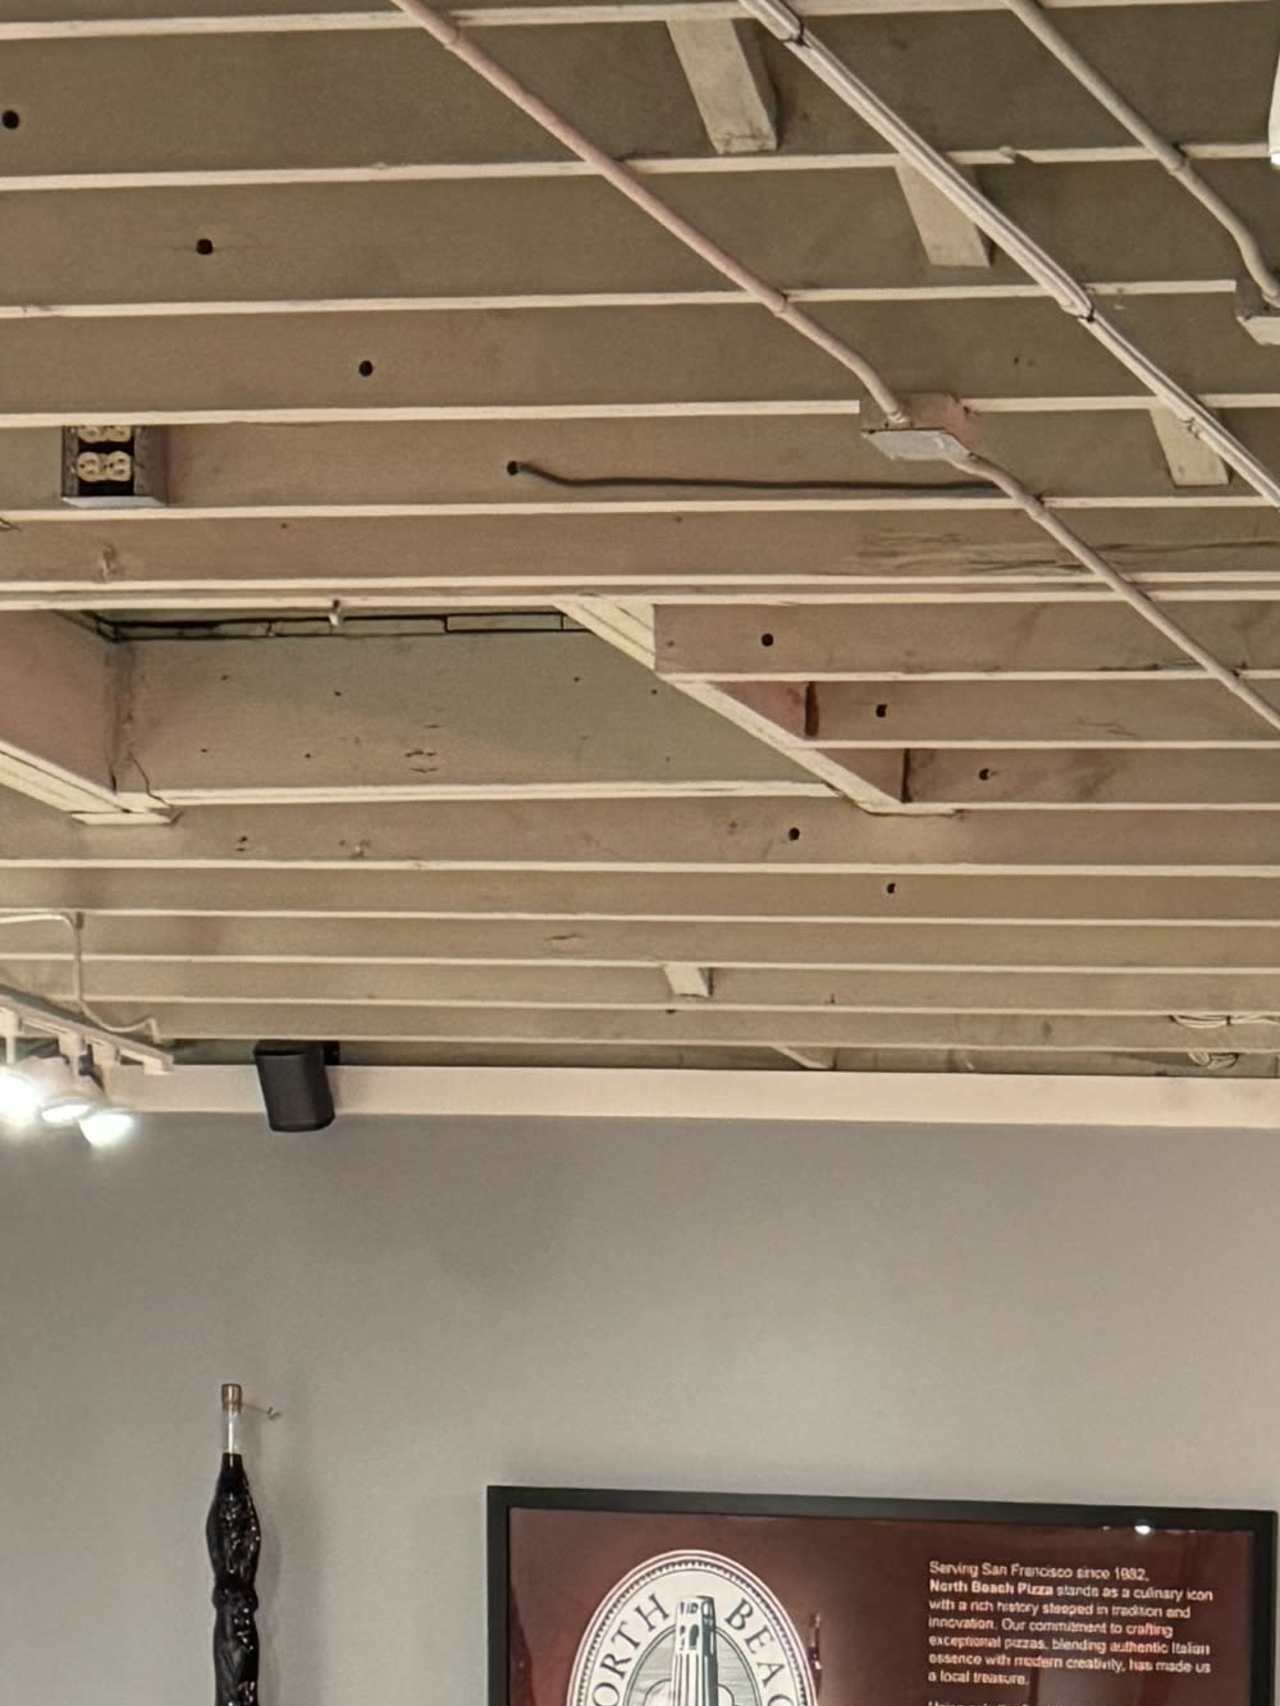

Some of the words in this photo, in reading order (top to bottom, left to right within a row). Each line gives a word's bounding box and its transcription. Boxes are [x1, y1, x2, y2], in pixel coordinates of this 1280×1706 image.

[929, 1561, 979, 1578] Serving
[982, 1563, 1008, 1576] San
[1010, 1564, 1073, 1579] Francisco
[1076, 1566, 1111, 1580] since
[929, 1578, 969, 1592] North
[971, 1580, 1015, 1594] Beach
[1017, 1582, 1054, 1596] Pizza
[1056, 1583, 1099, 1597] stands
[1102, 1588, 1119, 1598] as
[1122, 1588, 1131, 1598] a
[1133, 1586, 1184, 1603] culinary
[1186, 1588, 1213, 1601] icon
[929, 1597, 956, 1610] with
[958, 1600, 968, 1611] a
[970, 1598, 994, 1612] rich
[996, 1599, 1039, 1616] history
[1042, 1601, 1094, 1618] steeped
[1096, 1603, 1109, 1616] in
[1112, 1603, 1163, 1618] tradition
[1166, 1605, 1191, 1619] and
[1001, 1617, 1026, 1631] Our
[1028, 1618, 1107, 1634] commitment
[1110, 1621, 1123, 1634] to
[1125, 1622, 1174, 1639] crafting
[928, 1633, 1001, 1651] exceptional
[1052, 1637, 1107, 1655] blending
[1110, 1640, 1169, 1654] authentic
[1171, 1642, 1211, 1656] Italian
[928, 1653, 983, 1665] essence
[985, 1653, 1011, 1666] with
[1014, 1654, 1063, 1668] modern
[1129, 1658, 1154, 1671] has
[1155, 1659, 1193, 1673] made
[1195, 1663, 1211, 1674] us
[928, 1672, 937, 1682] a
[940, 1669, 970, 1683] local
